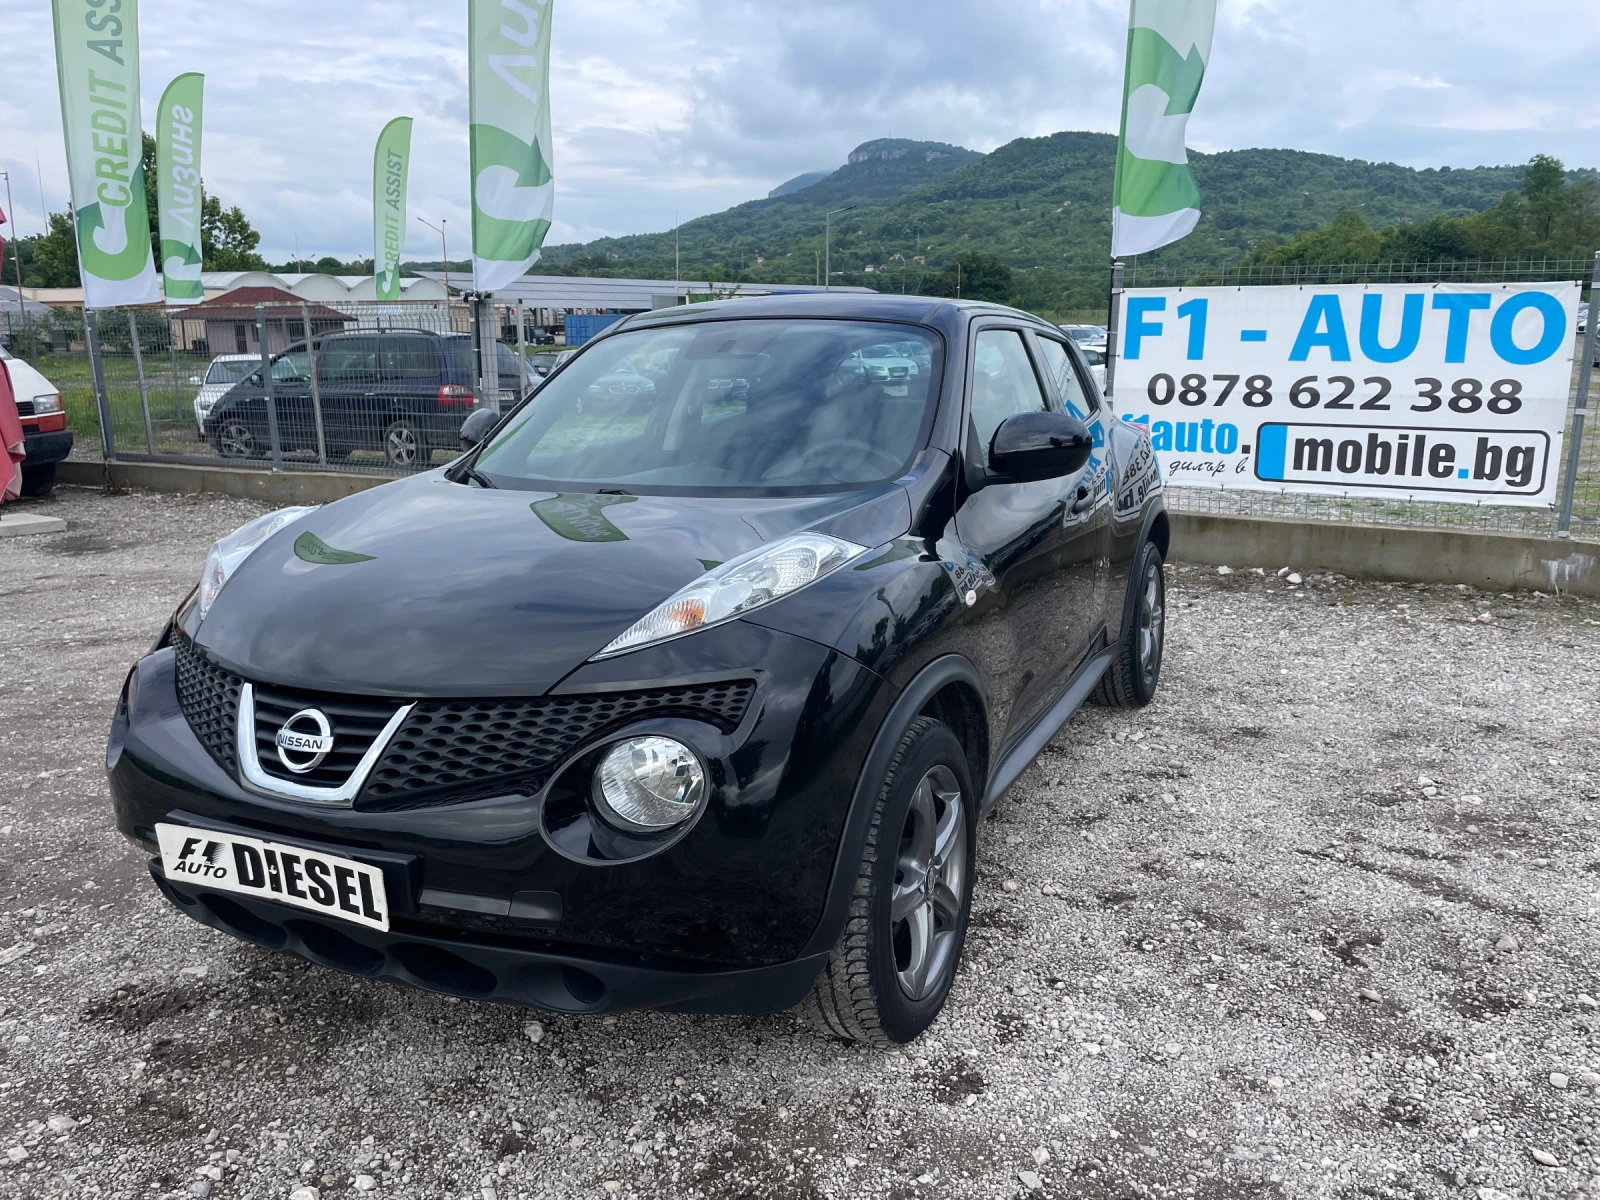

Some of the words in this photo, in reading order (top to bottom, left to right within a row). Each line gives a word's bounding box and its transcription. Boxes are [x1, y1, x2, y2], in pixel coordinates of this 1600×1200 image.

[88, 68, 132, 207] CREDIT
[386, 148, 403, 211] ASSIST
[384, 212, 399, 273] CREDIT
[1123, 297, 1208, 361] F1
[1240, 329, 1267, 342] -
[1289, 291, 1567, 365] AUTO
[1147, 373, 1273, 408] 0878
[1289, 375, 1392, 410] 622
[1410, 377, 1523, 414] 388
[1293, 433, 1537, 487] mobile.bg
[278, 733, 323, 750] NISSAN
[173, 860, 228, 879] AUTO
[231, 842, 383, 923] DIESEL
